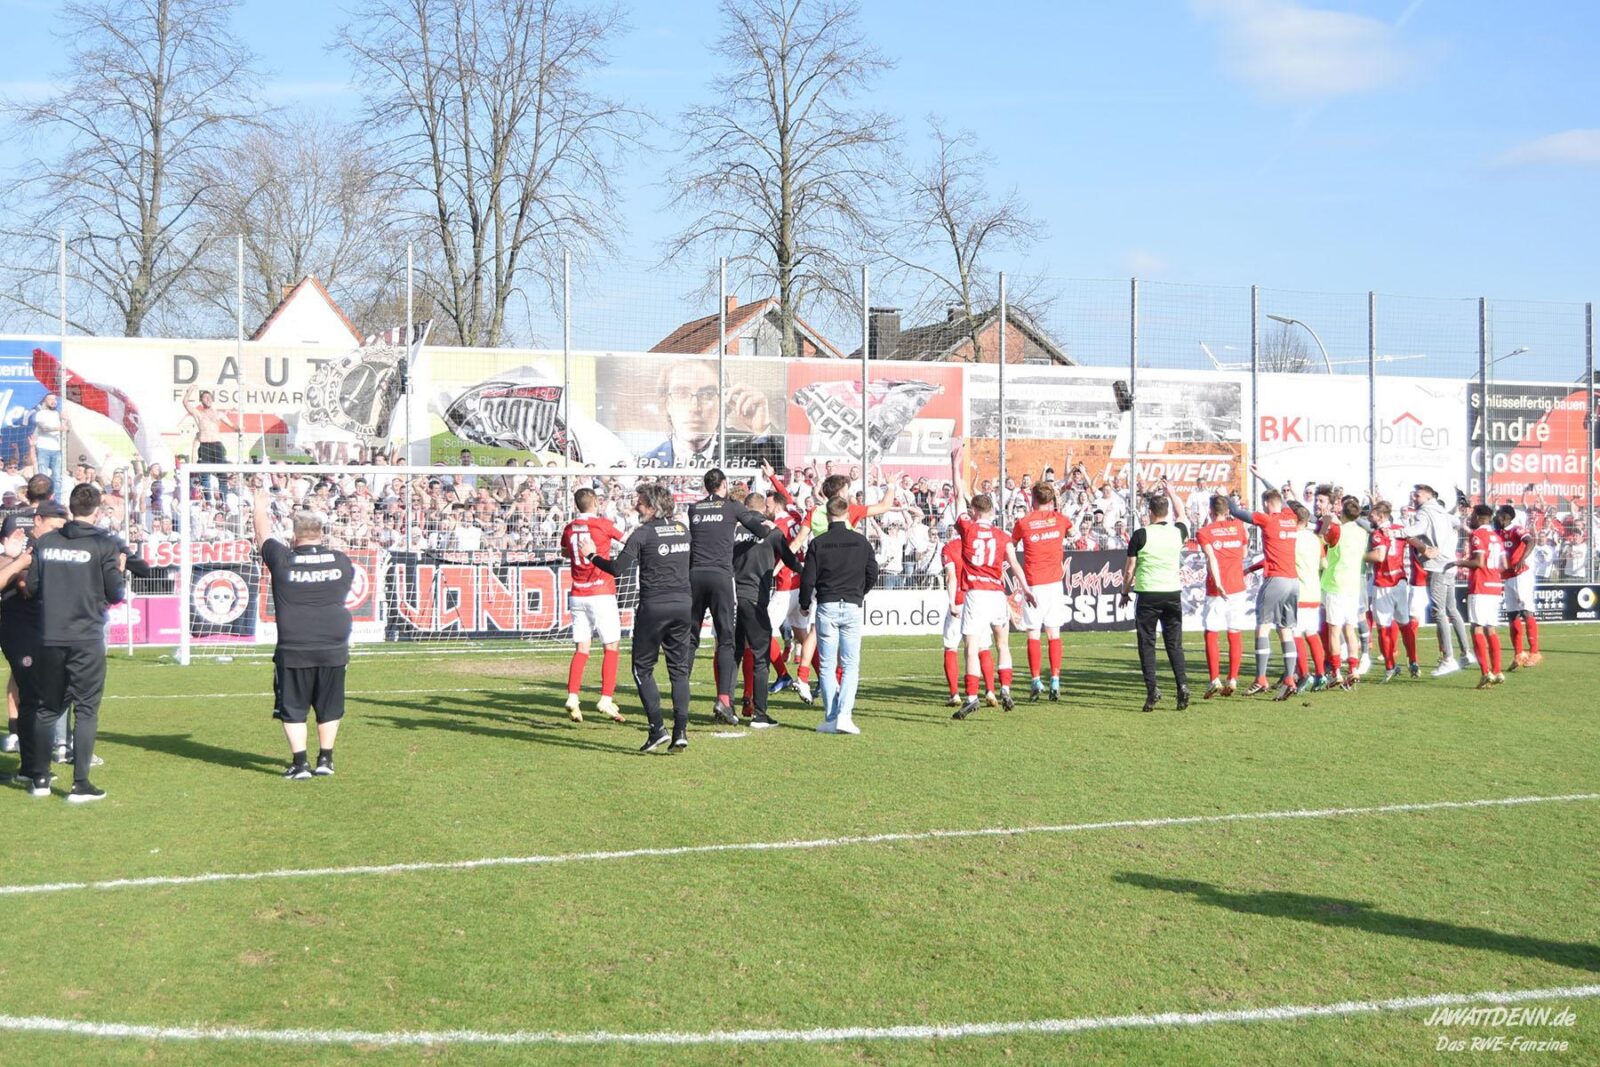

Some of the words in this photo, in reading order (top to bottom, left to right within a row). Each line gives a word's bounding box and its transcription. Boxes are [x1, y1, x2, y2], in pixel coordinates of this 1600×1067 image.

[1103, 461, 1232, 485] LANDWEHR
[702, 513, 724, 523] JAKO
[43, 548, 92, 563] HARFID
[971, 537, 997, 567] 31
[289, 568, 343, 583] HARFID
